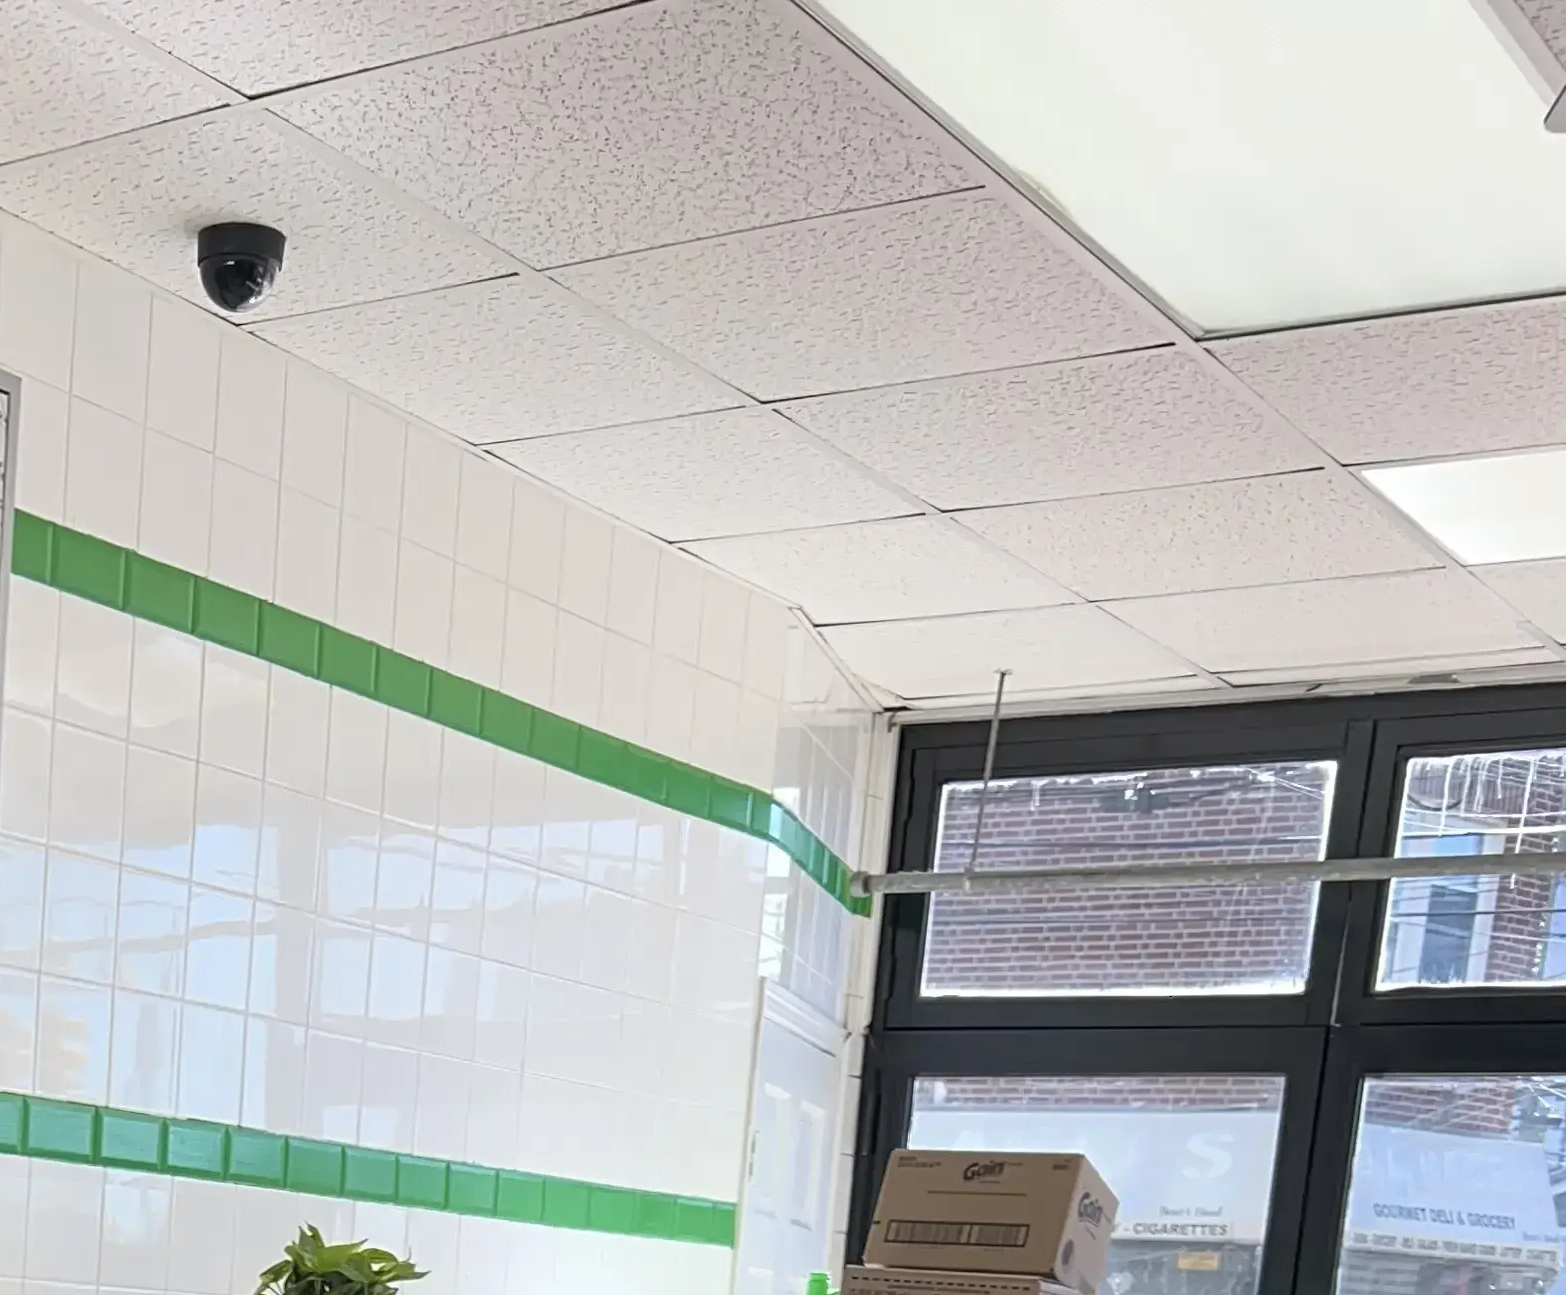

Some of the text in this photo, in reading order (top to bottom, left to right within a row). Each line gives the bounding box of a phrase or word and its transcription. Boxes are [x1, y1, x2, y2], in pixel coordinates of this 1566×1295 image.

[962, 1160, 1006, 1182] Gain
[1373, 1203, 1516, 1229] GOURMET DELI & GROCERY
[1132, 1222, 1228, 1237] CIGARETTES
